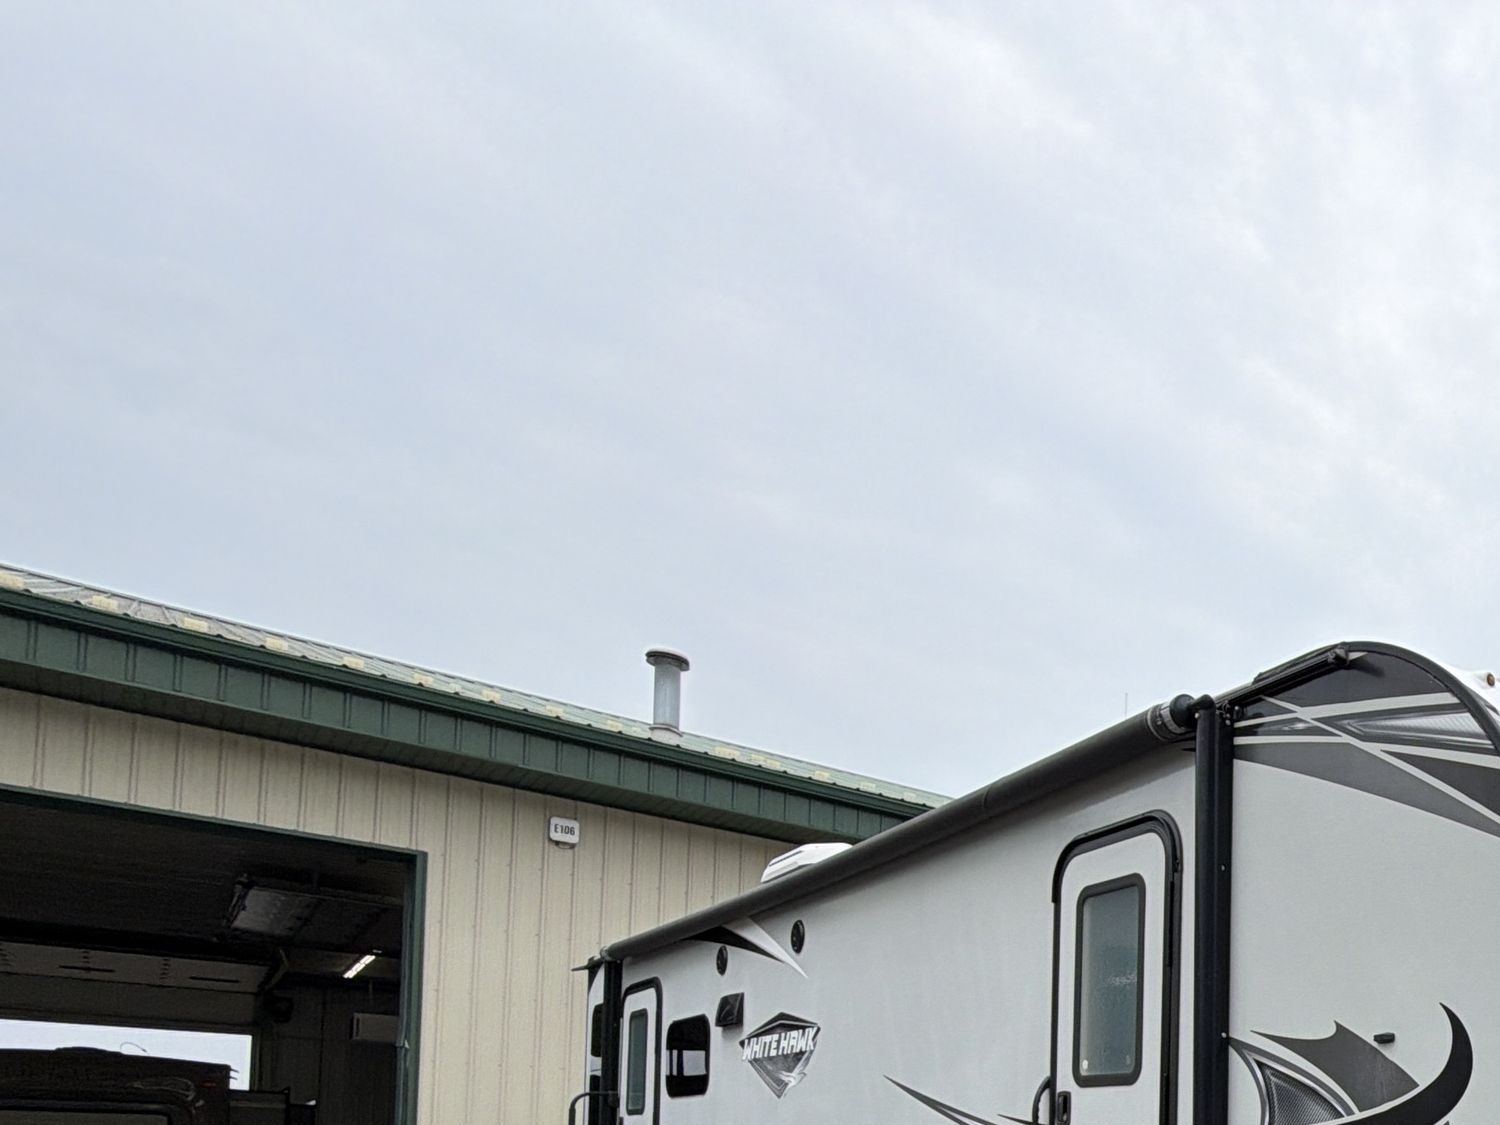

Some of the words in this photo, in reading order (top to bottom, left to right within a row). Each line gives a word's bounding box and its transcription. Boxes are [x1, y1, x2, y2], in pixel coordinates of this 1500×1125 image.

[554, 823, 575, 836] E106
[742, 1033, 779, 1060] WHITE
[778, 1027, 817, 1055] HAWK
